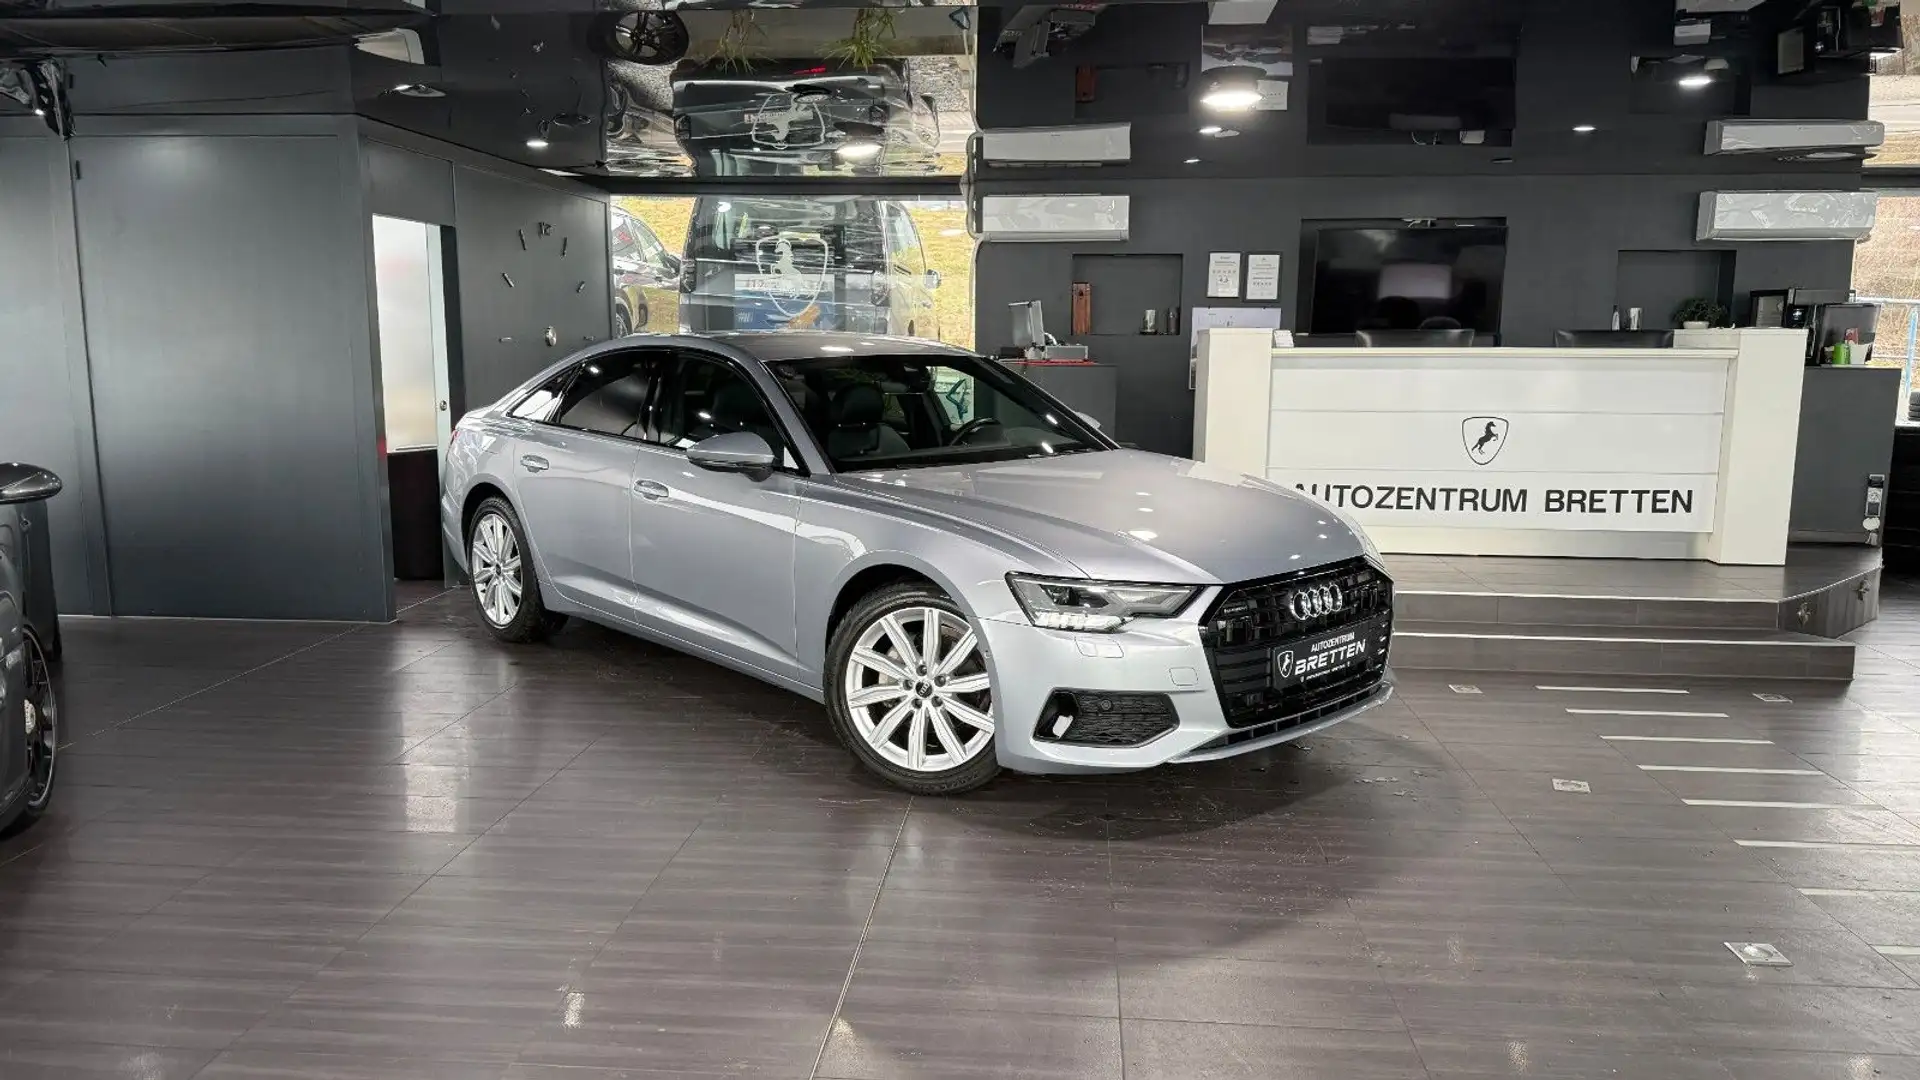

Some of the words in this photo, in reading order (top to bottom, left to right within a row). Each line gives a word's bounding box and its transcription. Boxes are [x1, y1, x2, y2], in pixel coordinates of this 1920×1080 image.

[1296, 483, 1528, 513] UTOZENTRUM
[1544, 489, 1693, 514] BRETTEN
[1294, 639, 1366, 675] BRETTEN
[1311, 632, 1355, 653] AUTOZENTRUM
